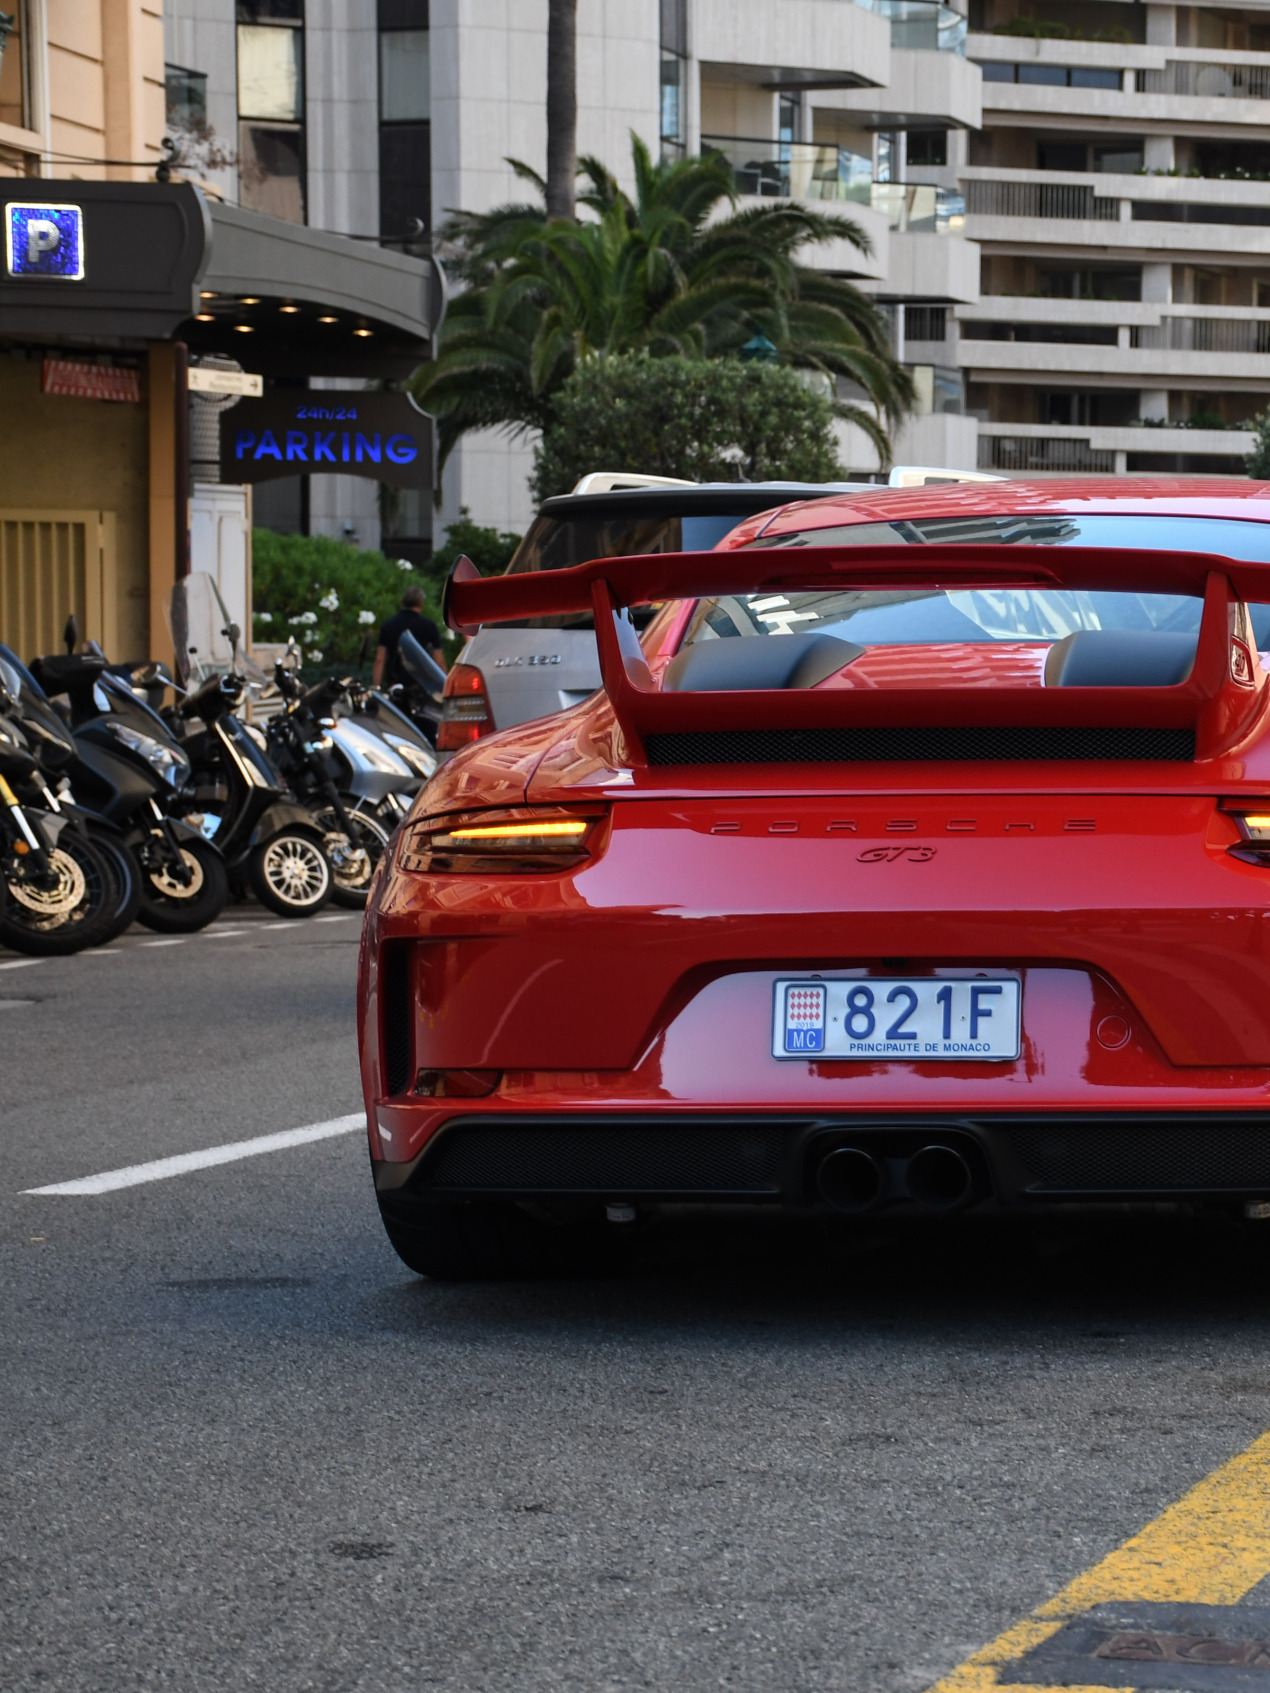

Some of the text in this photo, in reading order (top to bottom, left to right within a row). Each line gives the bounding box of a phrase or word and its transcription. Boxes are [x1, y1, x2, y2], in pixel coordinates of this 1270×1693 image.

[27, 218, 60, 263] P
[296, 406, 357, 420] 24h/24
[235, 430, 418, 464] PARKING
[710, 818, 1096, 834] PORSCHE
[856, 846, 938, 862] GT3
[844, 985, 1003, 1040] 821F
[795, 1021, 815, 1029] 2019
[793, 1031, 816, 1048] MC
[850, 1042, 991, 1052] PRINCIPAUTE DE MONACO
